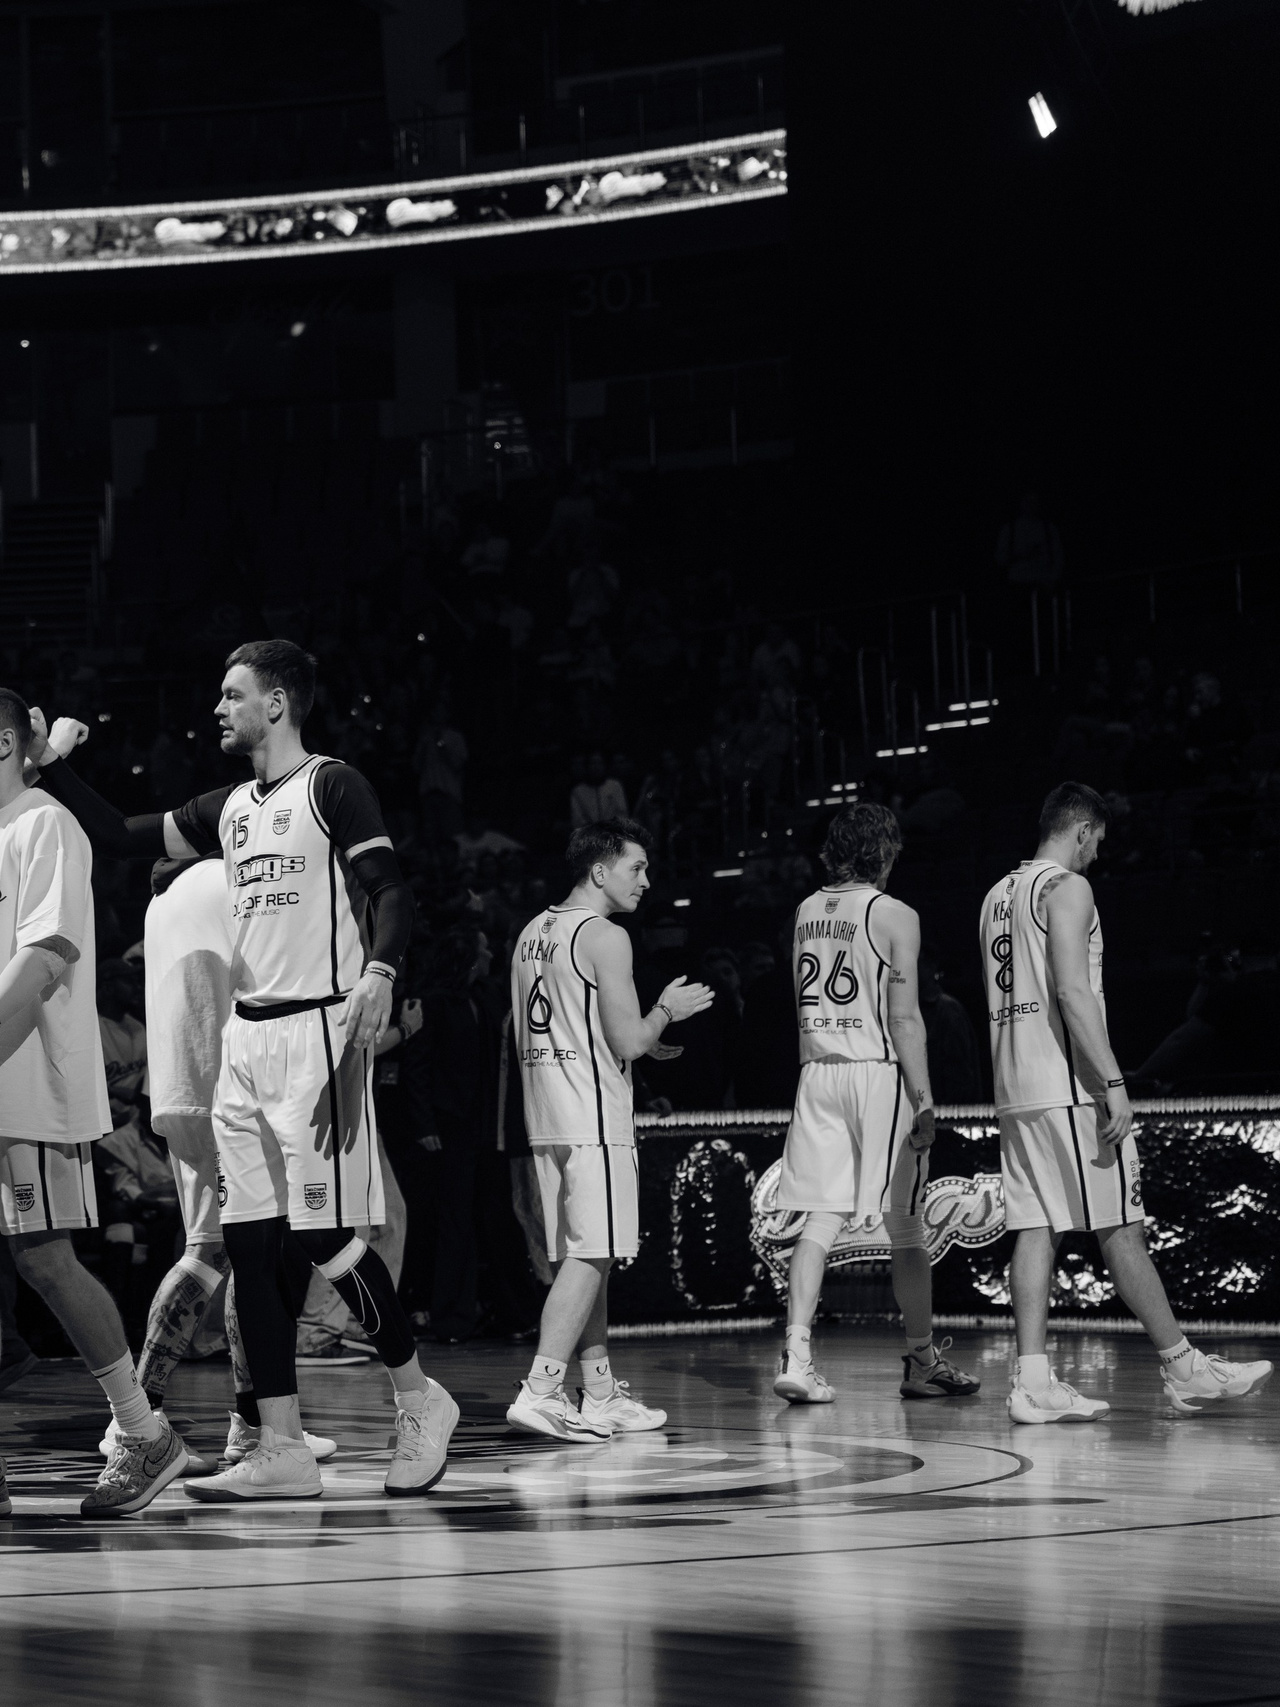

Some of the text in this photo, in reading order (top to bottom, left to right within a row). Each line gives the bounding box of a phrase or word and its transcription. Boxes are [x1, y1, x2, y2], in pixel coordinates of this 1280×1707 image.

[563, 265, 662, 318] 301
[232, 814, 250, 850] 15
[266, 892, 300, 907] REC
[798, 950, 859, 1008] 26
[991, 934, 1014, 993] 8
[527, 975, 552, 1035] 6
[813, 1018, 832, 1028] OF
[836, 1018, 863, 1029] REC
